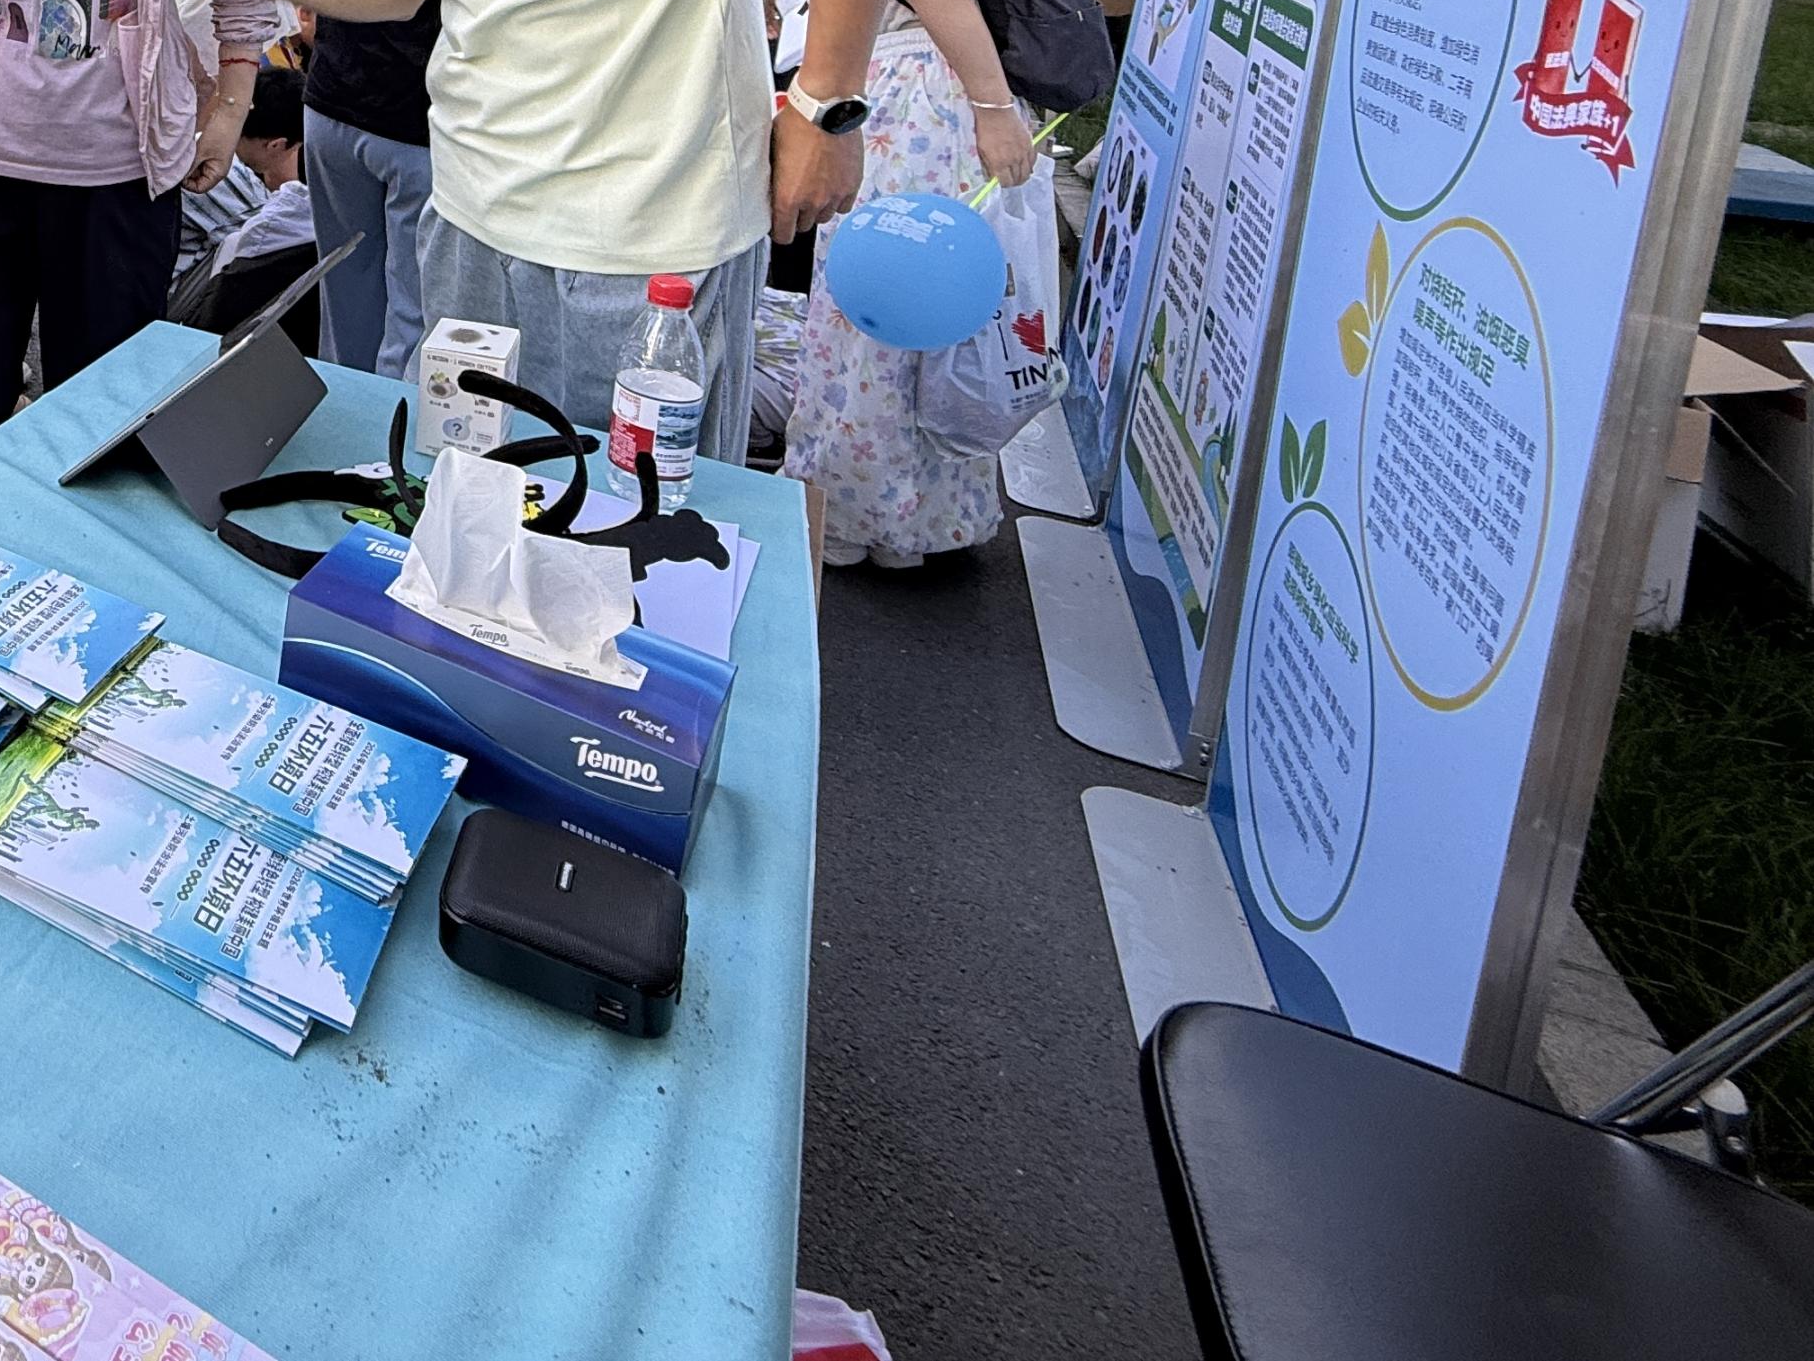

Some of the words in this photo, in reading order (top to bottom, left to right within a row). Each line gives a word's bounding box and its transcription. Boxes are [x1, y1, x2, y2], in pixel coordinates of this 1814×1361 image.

[366, 537, 405, 558] Tem
[34, 583, 86, 620] 全面绿色转型
[470, 623, 509, 645] Tempo
[264, 714, 339, 795] 六五环境日
[322, 719, 366, 769] 全面绿色转型
[569, 735, 659, 783] Tempo
[290, 765, 336, 817] 构建美丽中国
[191, 834, 263, 935] 六五环境日
[250, 849, 289, 900] 面绿色转型
[220, 894, 264, 959] 构建美丽中国
